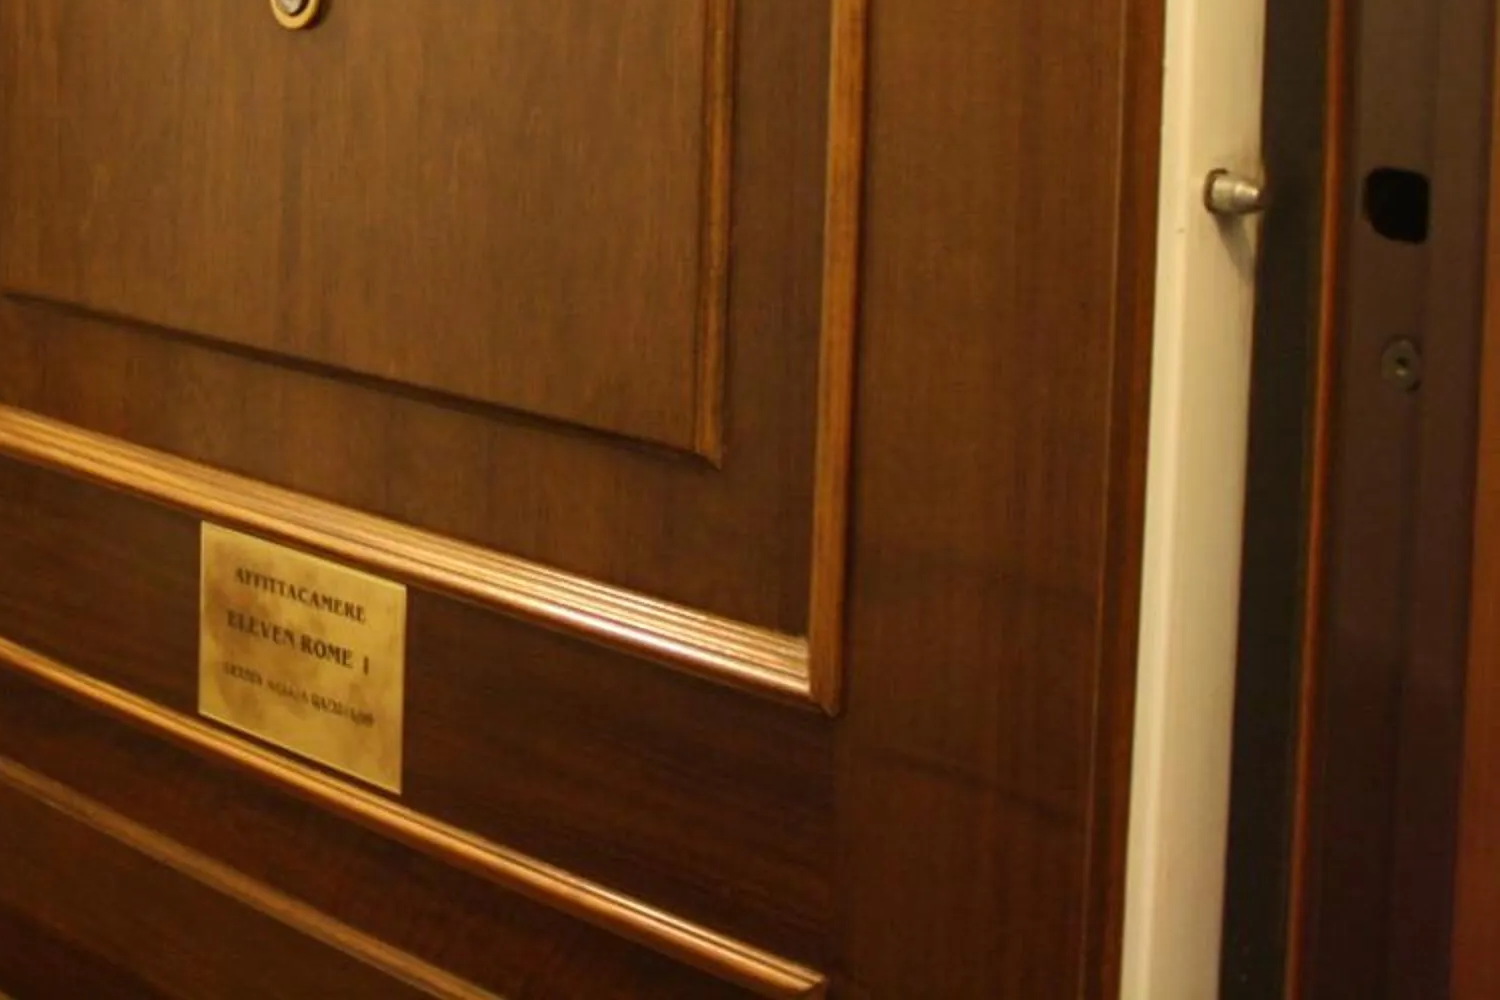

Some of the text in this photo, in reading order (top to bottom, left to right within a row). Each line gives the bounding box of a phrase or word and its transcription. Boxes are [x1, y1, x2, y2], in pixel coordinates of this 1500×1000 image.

[235, 566, 367, 624] AFFITTACAMERE
[227, 609, 296, 649] ELEVEN
[300, 635, 353, 669] ROME
